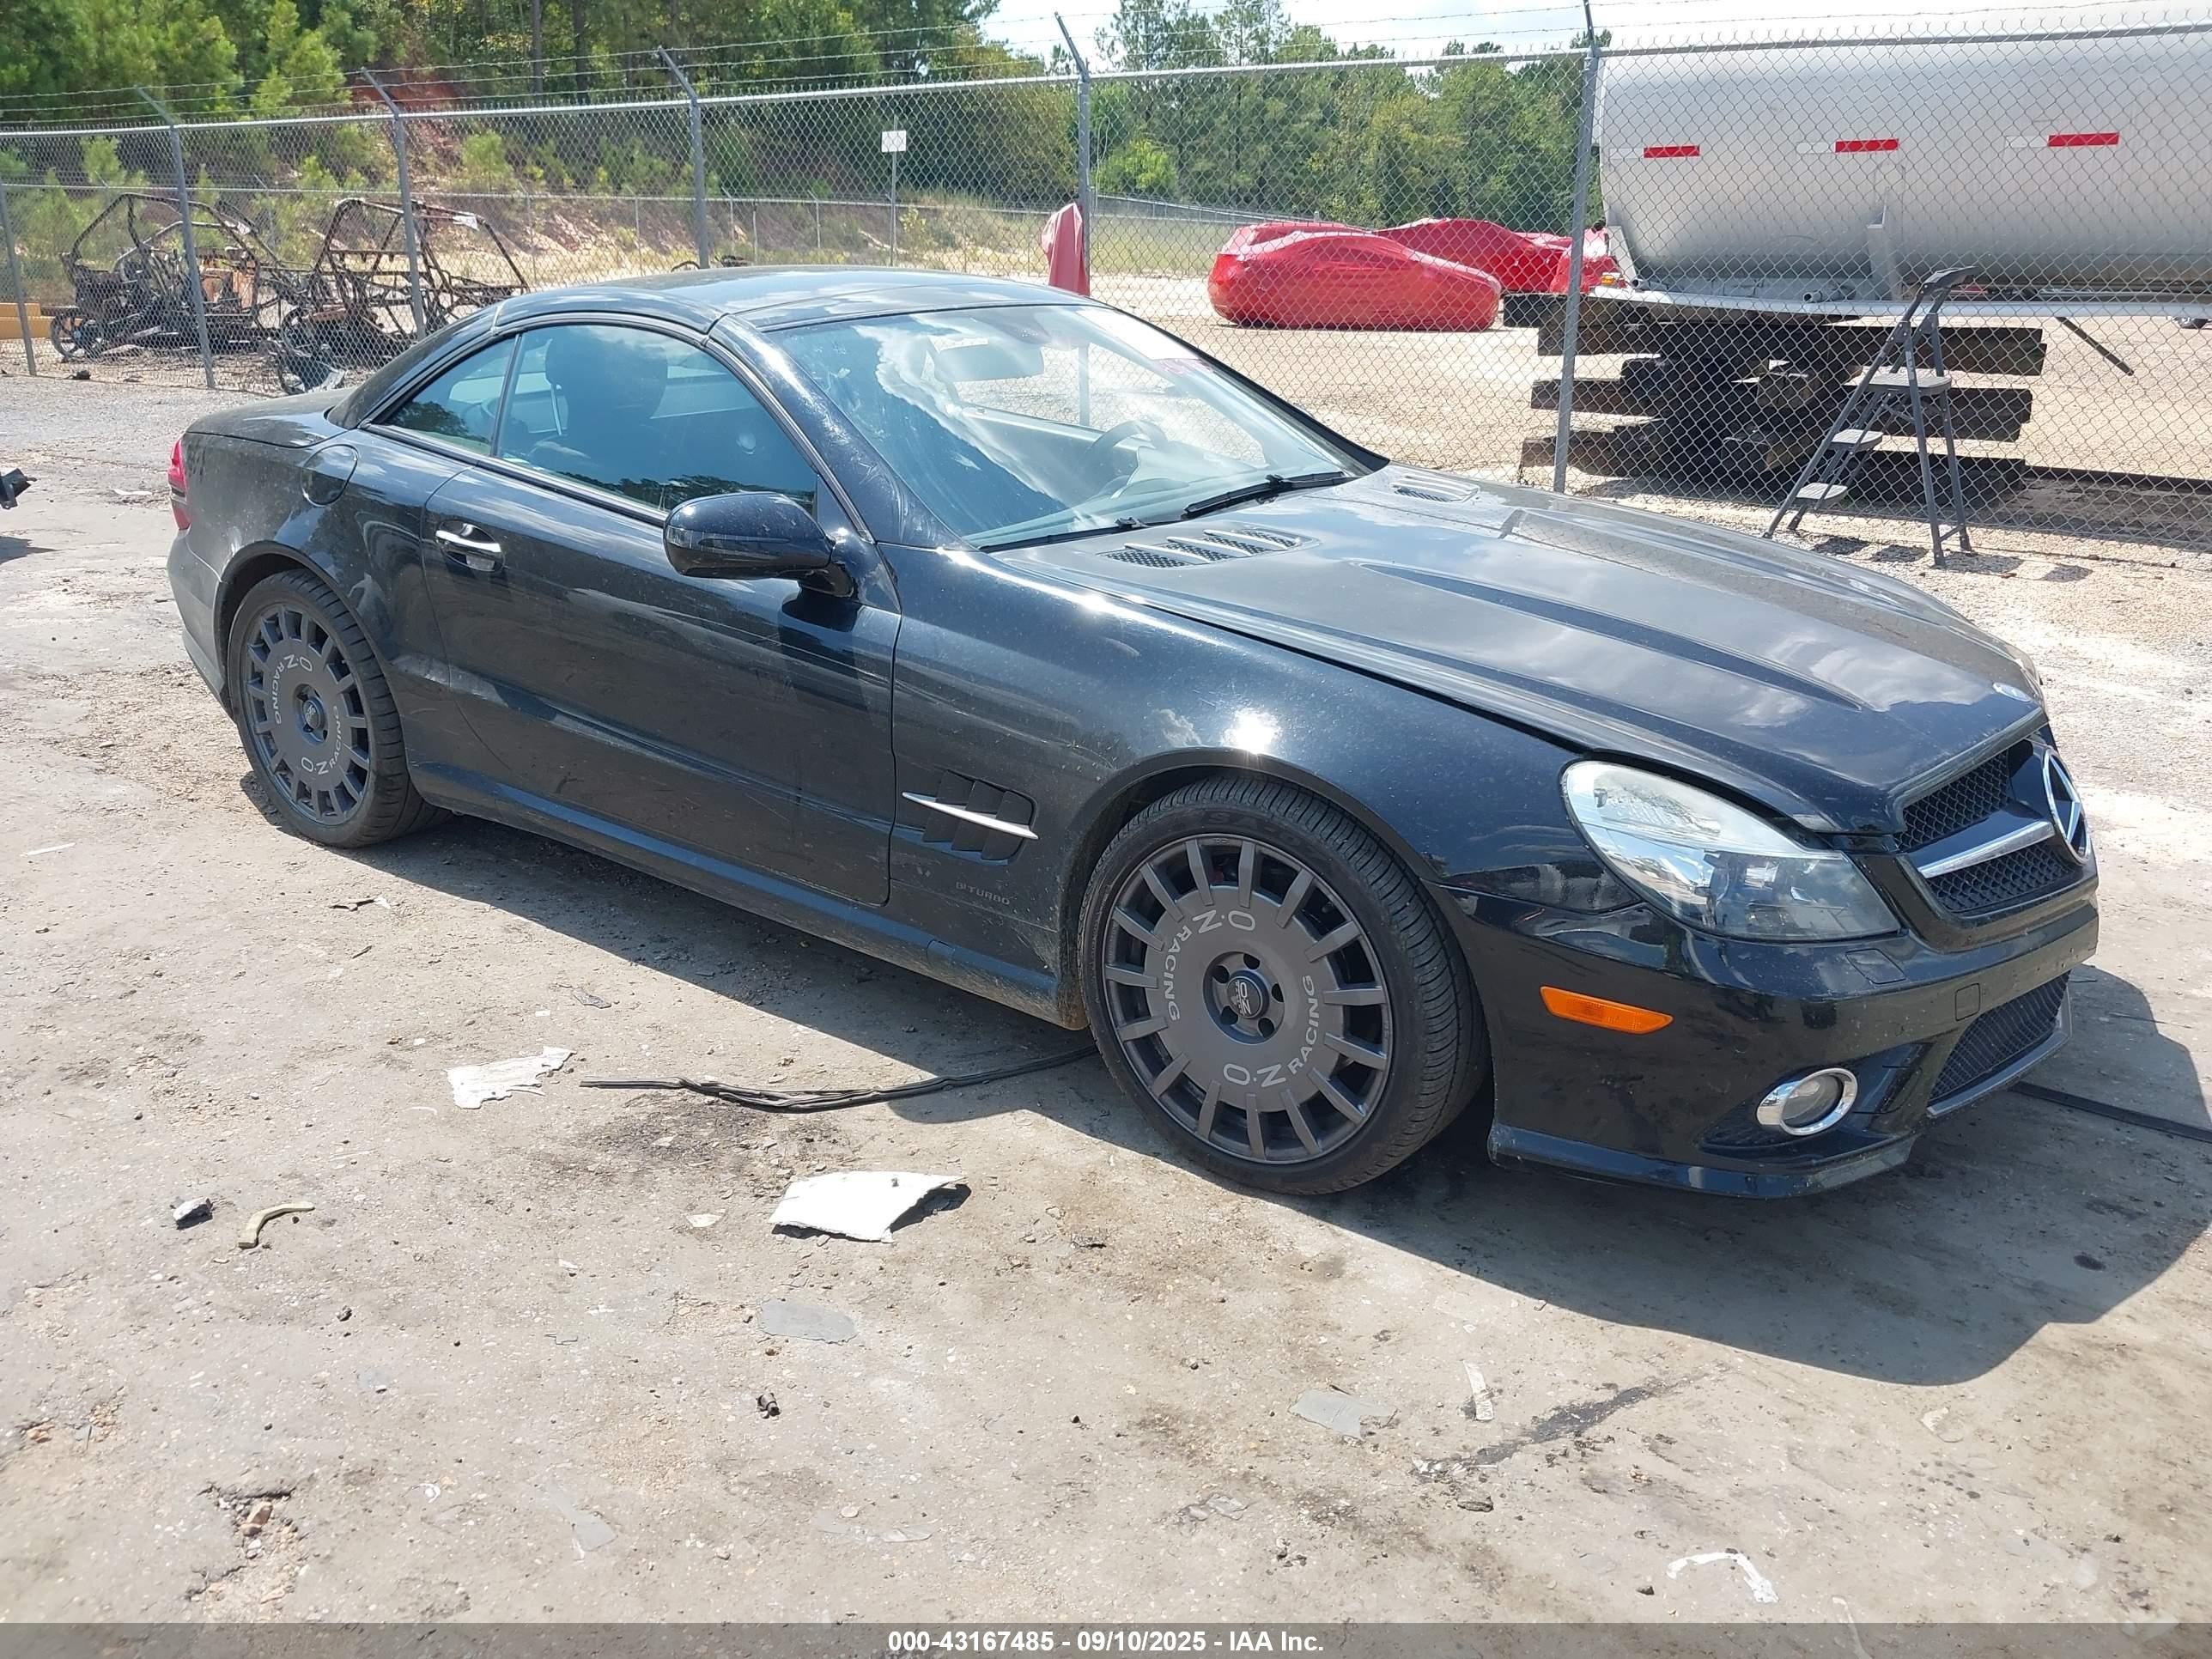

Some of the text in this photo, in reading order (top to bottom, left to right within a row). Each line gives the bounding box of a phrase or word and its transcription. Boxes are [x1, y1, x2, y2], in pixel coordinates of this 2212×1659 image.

[272, 661, 285, 725] RACING
[329, 705, 342, 769] RACING
[955, 881, 1011, 905] BITURBO
[1163, 925, 1193, 1022] RACING
[1287, 975, 1320, 1075] RACING
